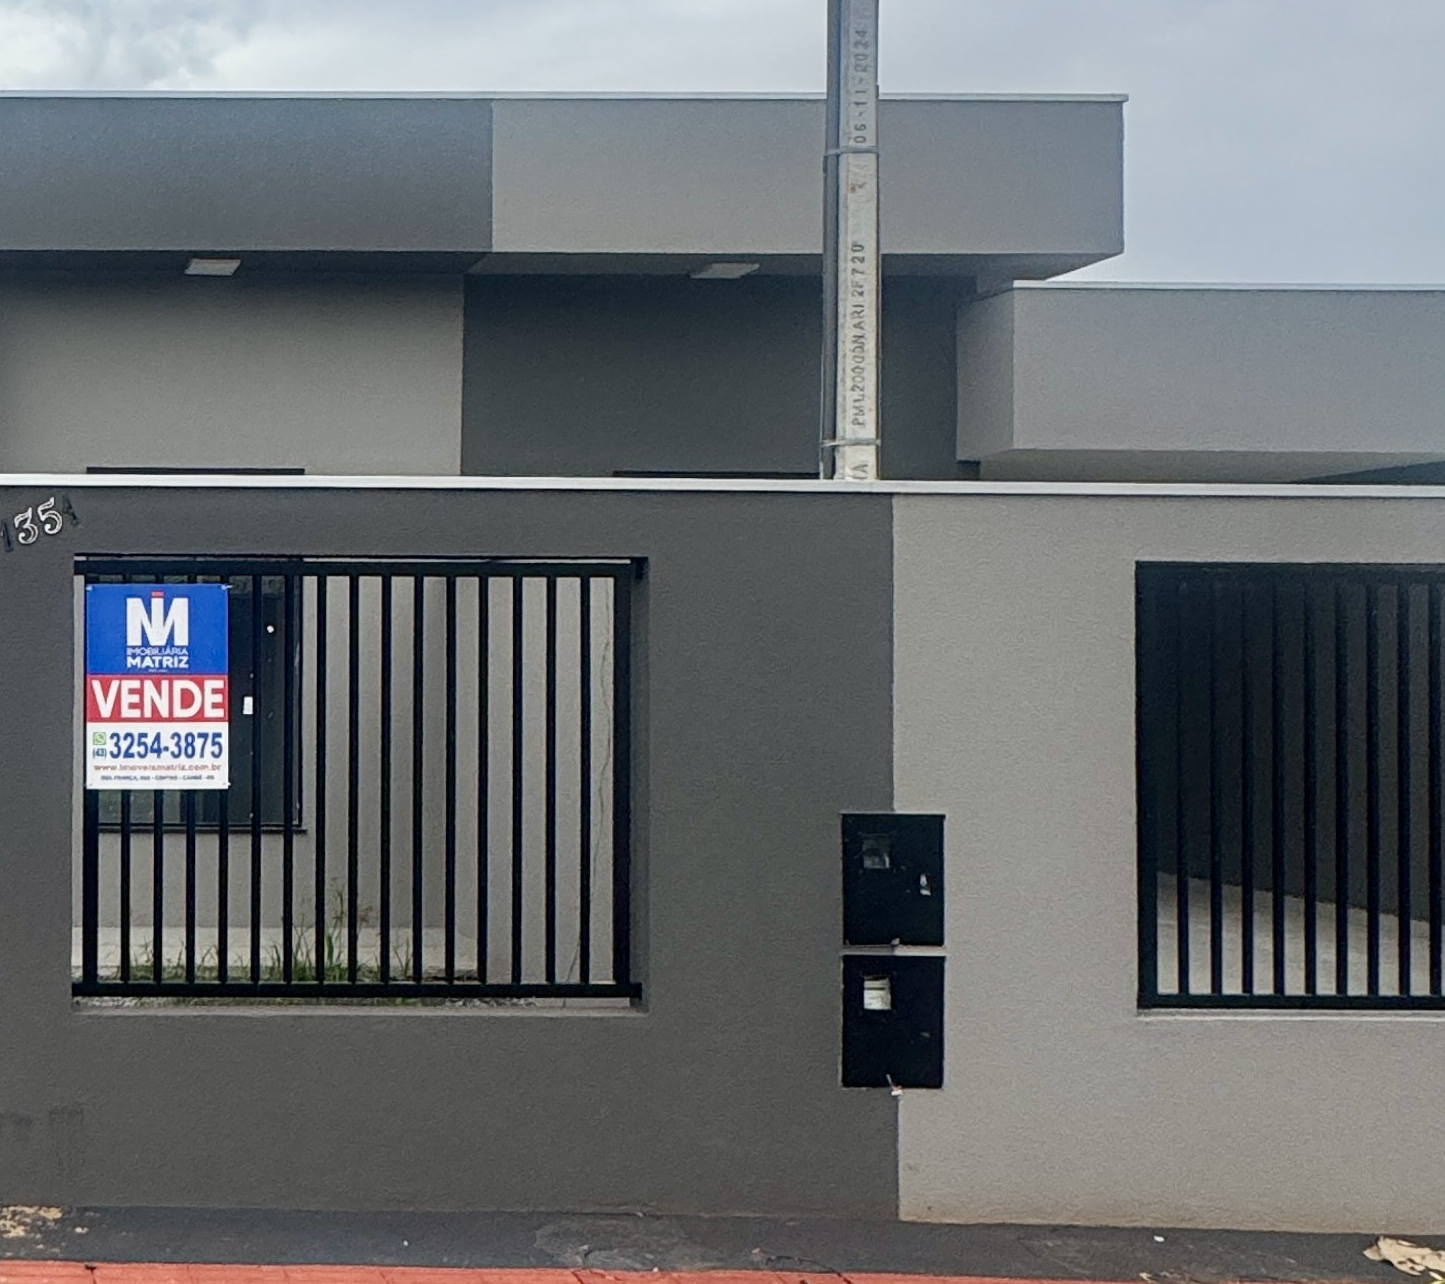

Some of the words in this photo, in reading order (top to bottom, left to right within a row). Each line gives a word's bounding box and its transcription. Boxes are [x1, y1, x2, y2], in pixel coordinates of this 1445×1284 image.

[126, 656, 189, 669] MATRIZ
[91, 679, 225, 718] VENDE
[109, 732, 223, 759] 3254-3875
